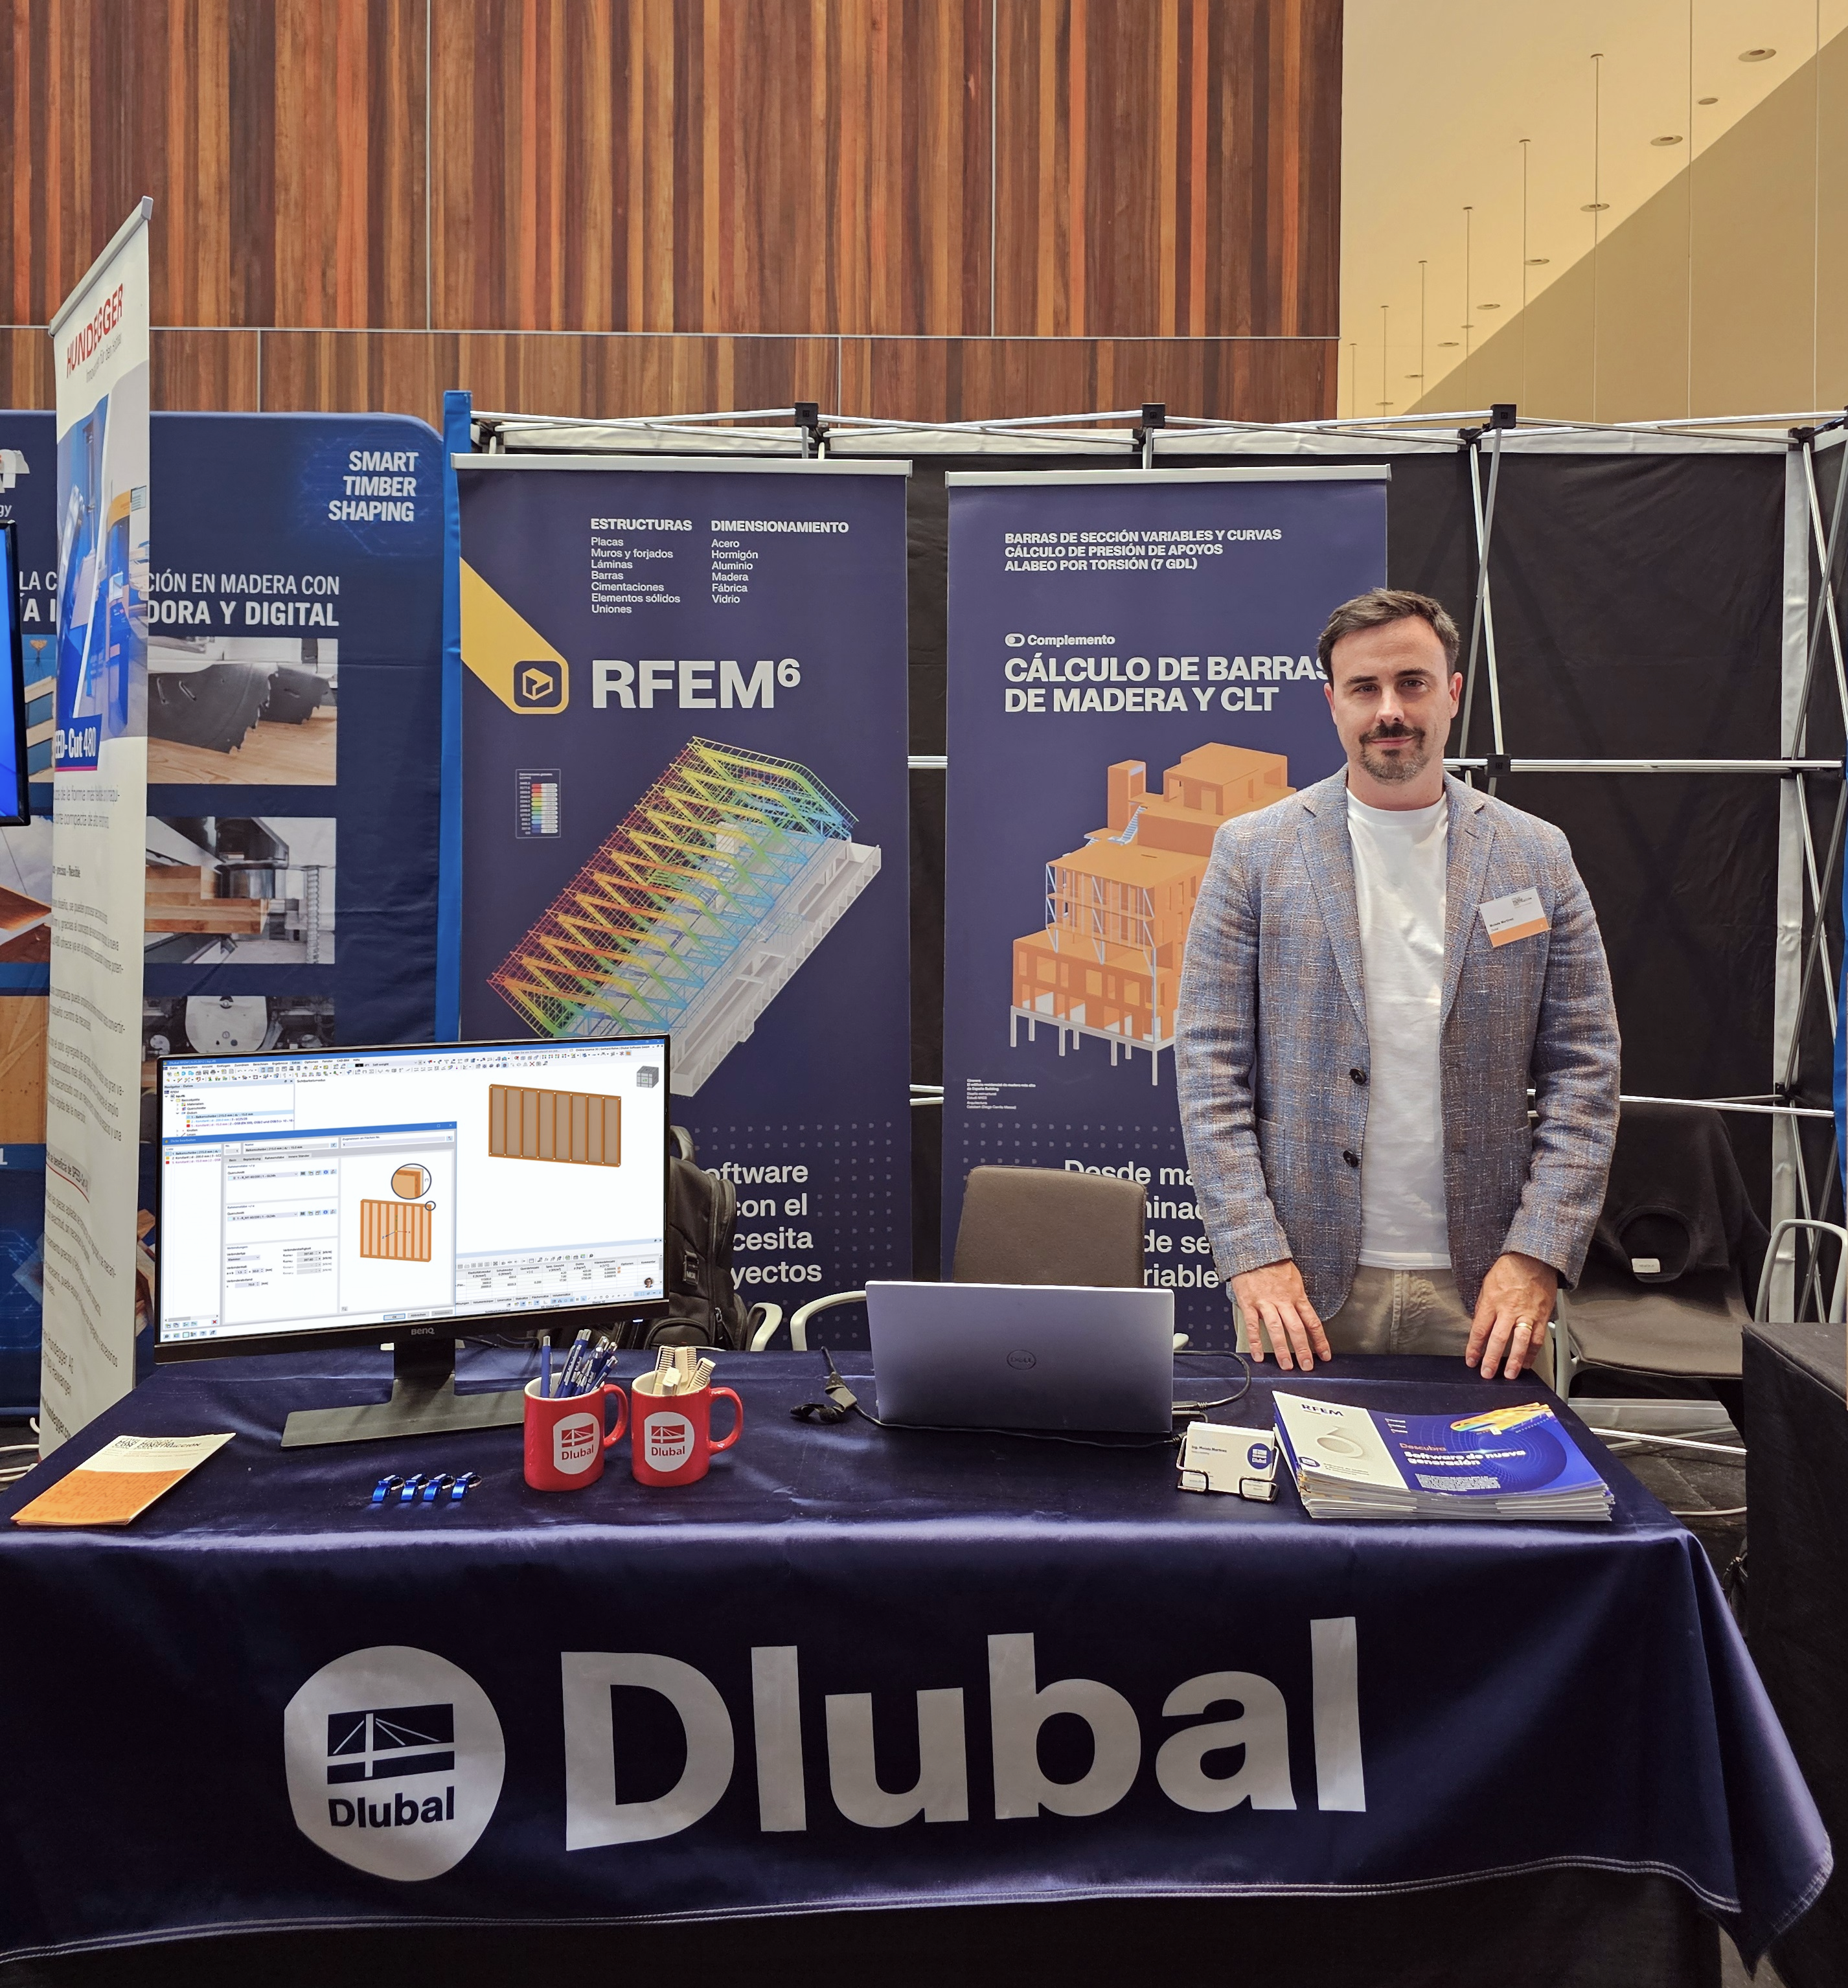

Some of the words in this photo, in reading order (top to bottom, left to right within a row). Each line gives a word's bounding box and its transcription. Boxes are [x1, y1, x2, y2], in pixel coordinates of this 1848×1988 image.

[67, 283, 123, 378] HUNDEGGER
[348, 450, 419, 472] SMART
[343, 475, 417, 497] TIMBER
[328, 500, 415, 522] SHAPING
[591, 518, 692, 531] ESTRUCTURAS
[711, 520, 849, 533] DIMENSIONAMIENTO
[591, 536, 624, 547] Placas
[711, 538, 740, 548] Acero
[1005, 532, 1058, 544] BARRAS
[1060, 532, 1078, 543] DE
[1080, 529, 1139, 543] SECCIÓN
[1141, 530, 1214, 542] VARIABLES
[1215, 530, 1226, 541] Y
[1227, 529, 1282, 541] CURVAS
[591, 548, 623, 558] Muros
[624, 551, 632, 560] y
[632, 548, 674, 560] forjados
[711, 549, 759, 561] Hormigón
[1005, 544, 1066, 558] CÁLCULO
[1067, 546, 1086, 557] DE
[1088, 543, 1146, 556] PRESIÓN
[1148, 545, 1166, 556] DE
[1167, 543, 1224, 556] APOYOS
[591, 559, 633, 569] Láminas
[711, 560, 753, 570] Aluminio
[1004, 560, 1058, 571] ALABEO
[1060, 560, 1088, 571] POR
[1089, 556, 1148, 571] TORSIÓN
[1150, 558, 1164, 571] (7
[1165, 557, 1198, 570] GDL)
[591, 570, 624, 580] Barras
[712, 572, 749, 582] Madera
[19, 571, 41, 590] LA
[192, 573, 215, 593] EN
[221, 573, 298, 595] MADERA
[301, 575, 339, 595] CON
[591, 581, 665, 591] Cimentaciones
[712, 583, 748, 593] Fábrica
[591, 593, 644, 602] Elementos
[645, 593, 681, 603] sólidos
[711, 594, 740, 604] Vidrio
[220, 600, 236, 624] Y
[245, 601, 339, 626] DIGITAL
[591, 604, 632, 614] Uniones
[1027, 634, 1115, 648] Complemento
[1005, 652, 1150, 682] CÁLCULO
[1158, 656, 1200, 681] DE
[1005, 688, 1046, 713] DE
[1053, 687, 1189, 713] MADERA
[1192, 687, 1216, 711] Y
[1220, 687, 1279, 712] CLT
[69, 728, 83, 758] Cut
[83, 727, 96, 757] 480
[702, 1162, 808, 1184] oftware
[737, 1199, 776, 1217] on
[784, 1193, 807, 1215] el
[1301, 1404, 1343, 1416] RFEM
[561, 1445, 594, 1460] Dlubal
[650, 1446, 685, 1456] Dlubal
[1399, 1443, 1446, 1452] Descubra
[1404, 1451, 1465, 1460] Software
[1485, 1450, 1525, 1459] nueva
[561, 1617, 1366, 1851] Dlubal
[328, 1785, 455, 1827] Dlubal
